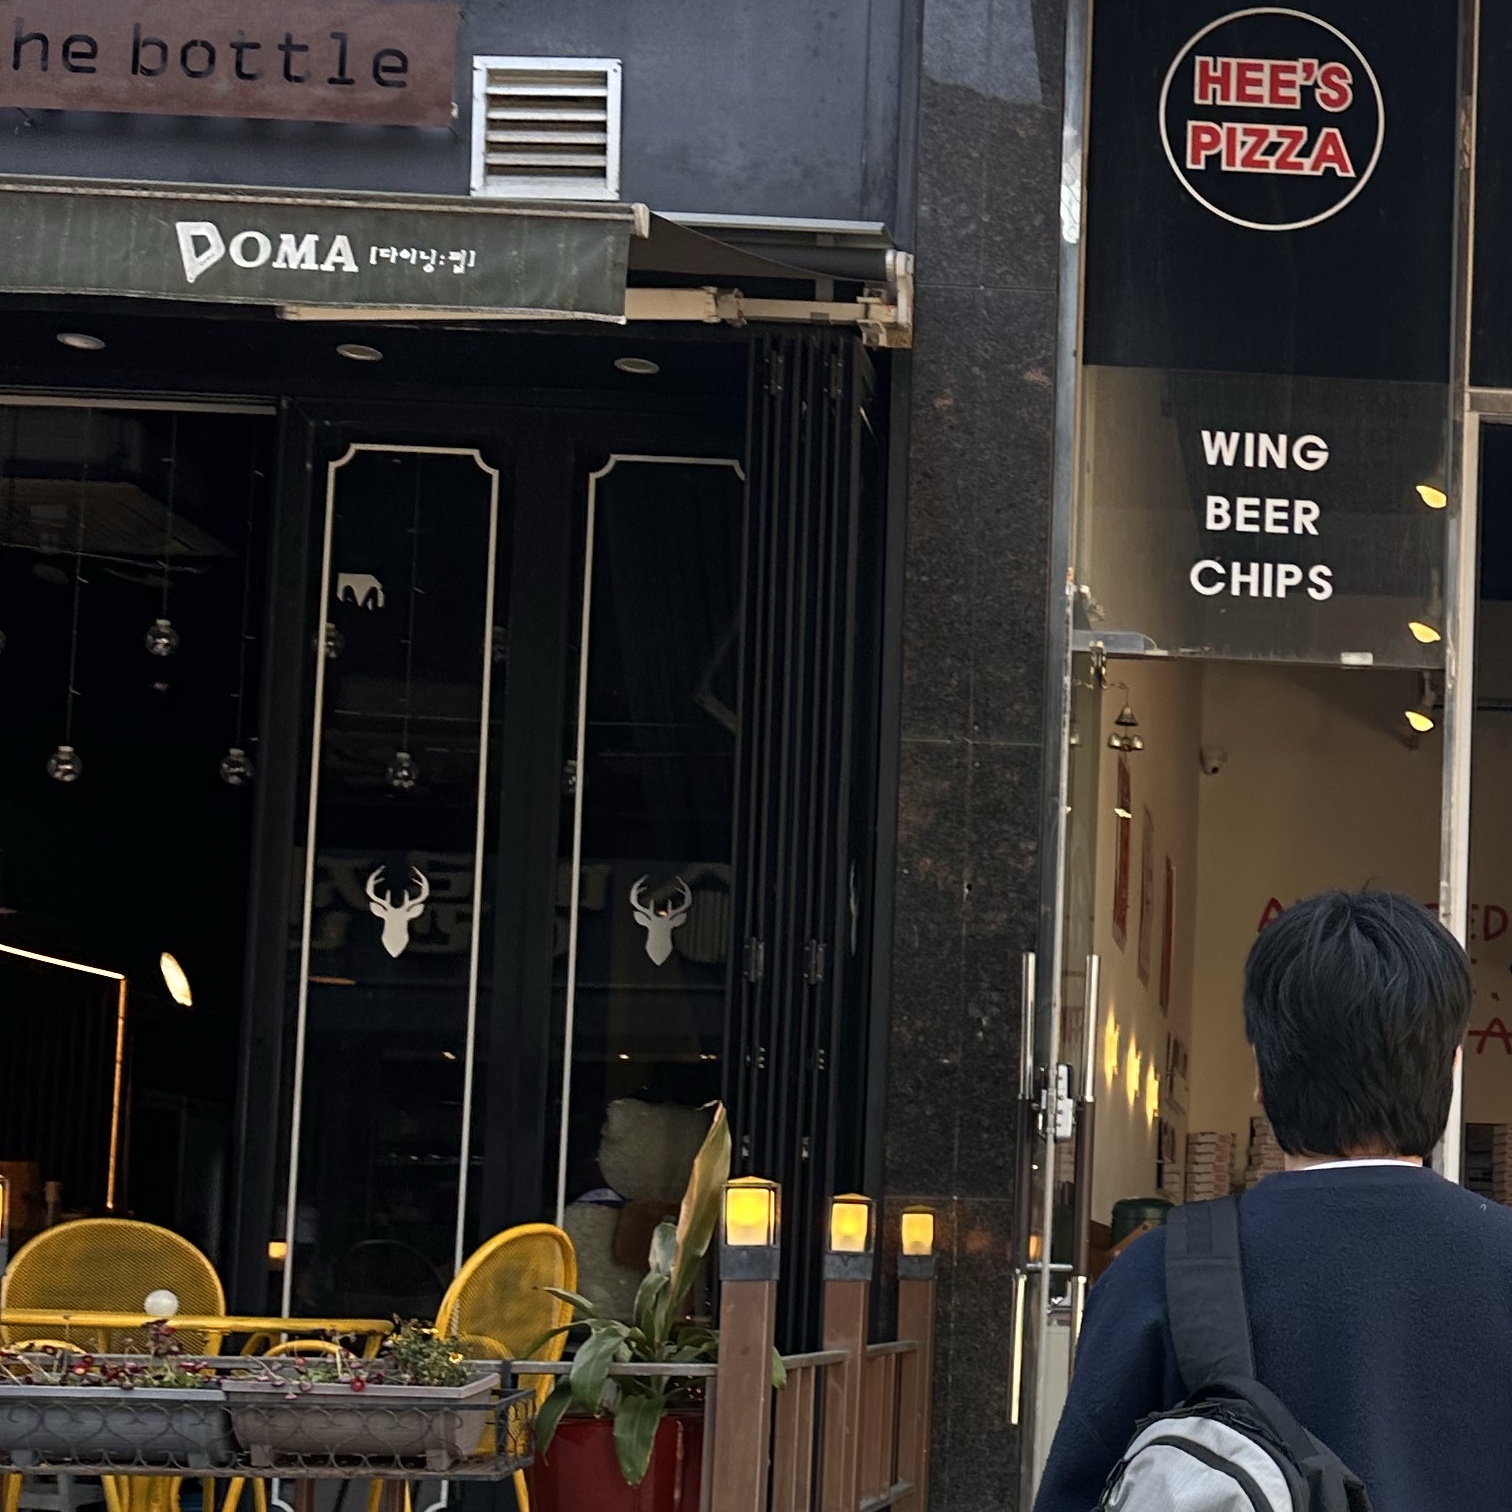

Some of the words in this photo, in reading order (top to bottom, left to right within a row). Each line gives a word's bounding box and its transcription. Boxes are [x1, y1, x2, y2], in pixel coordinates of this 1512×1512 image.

[130, 23, 410, 88] bottle
[1194, 55, 1353, 112] HEE'S
[1186, 120, 1356, 178] PIZZA
[1201, 429, 1330, 472] WING
[1206, 496, 1320, 535] BEER
[1189, 559, 1334, 601] CHIPS
